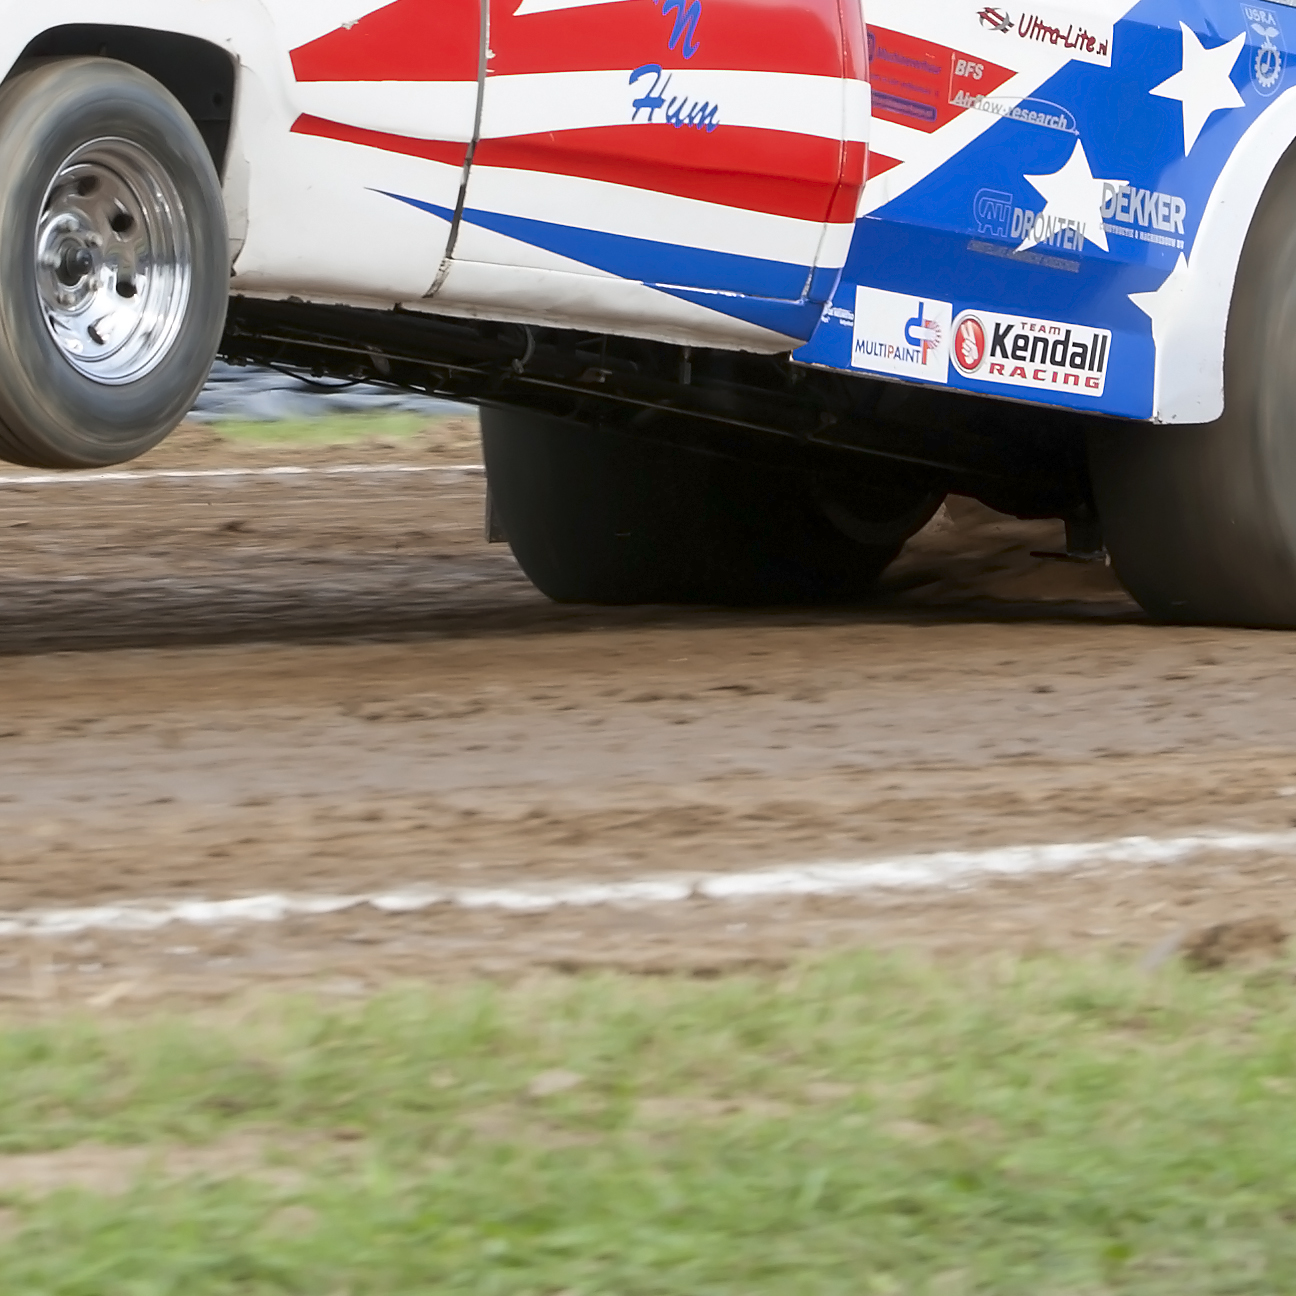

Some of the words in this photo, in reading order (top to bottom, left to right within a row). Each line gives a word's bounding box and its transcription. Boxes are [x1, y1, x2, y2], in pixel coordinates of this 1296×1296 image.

[1245, 7, 1277, 26] USRA
[955, 59, 984, 80] BFS
[629, 64, 720, 133] Hum
[1100, 182, 1187, 235] DEKKER
[1011, 207, 1086, 252] DRONTEN
[1021, 322, 1061, 336] TEAM
[855, 339, 921, 364] MULTIPAINT
[990, 322, 1108, 373] Kendall
[989, 363, 1101, 389] RACING
